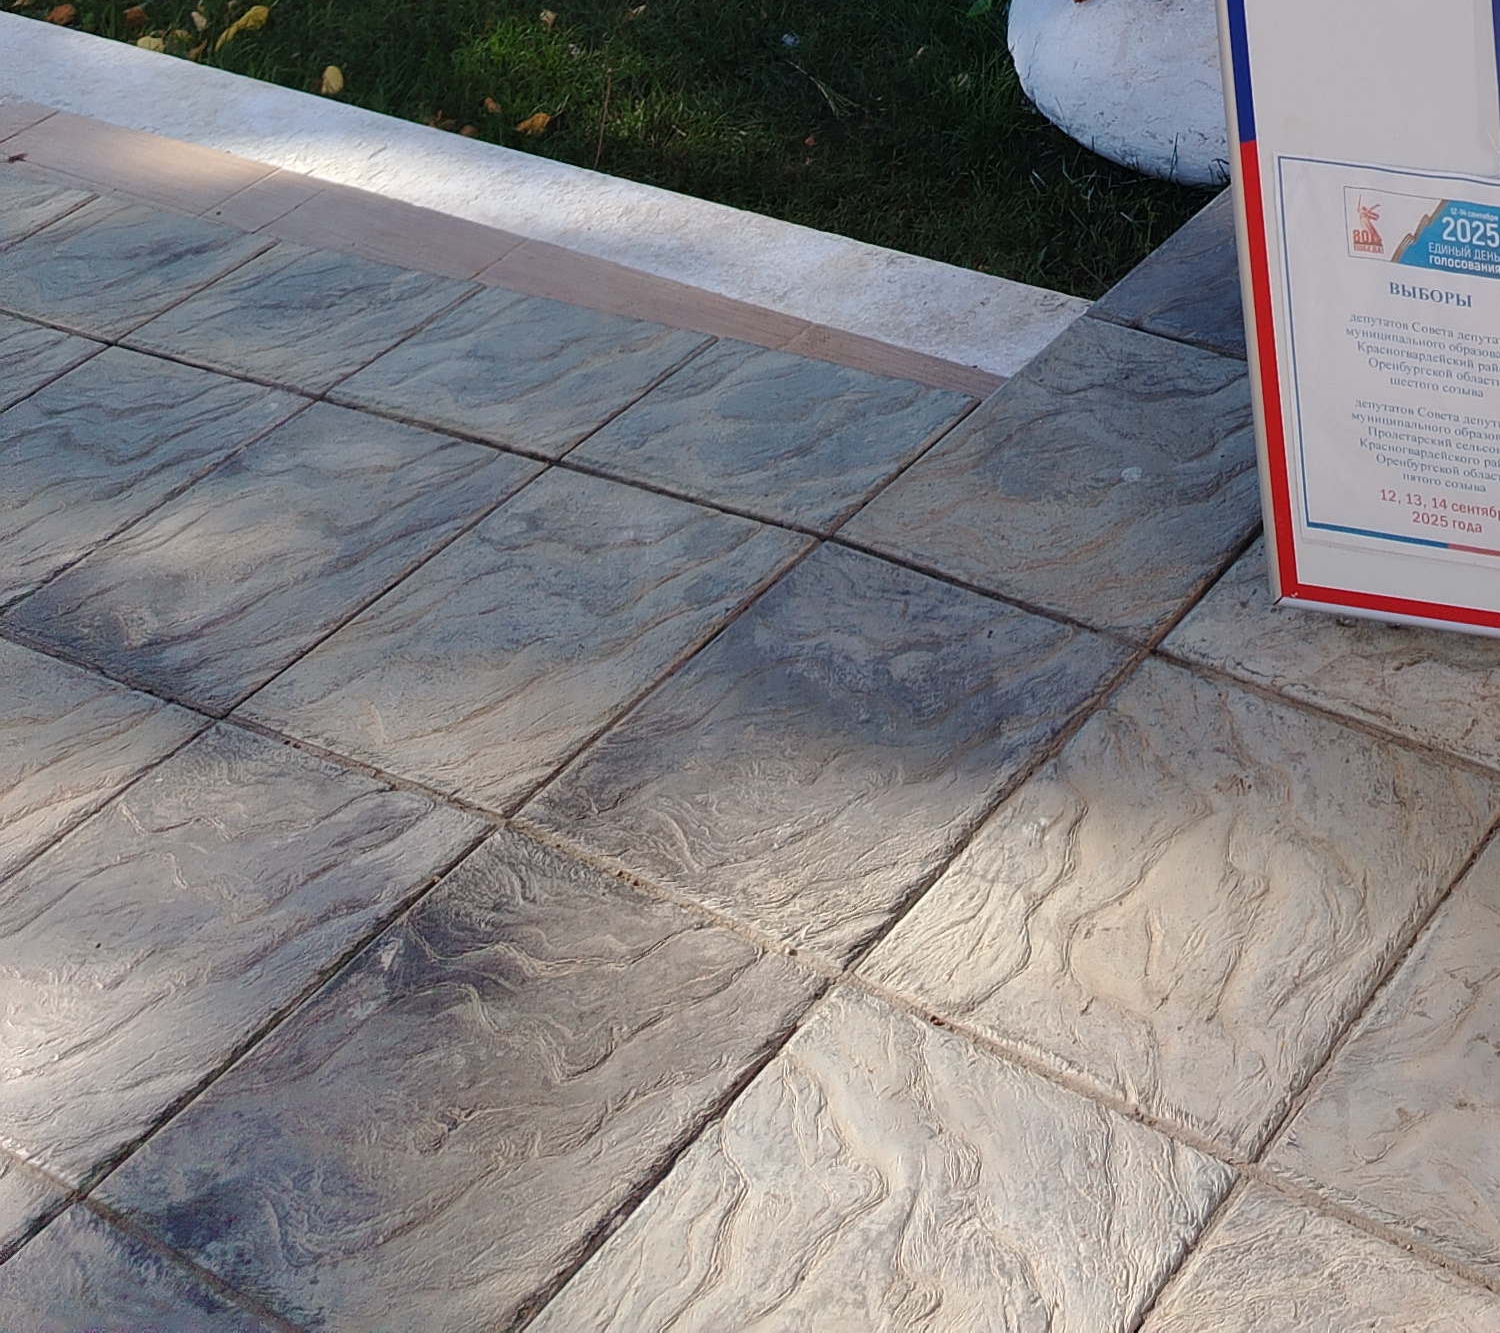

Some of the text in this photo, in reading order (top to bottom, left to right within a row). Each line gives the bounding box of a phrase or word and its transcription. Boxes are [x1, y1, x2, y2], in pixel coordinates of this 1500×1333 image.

[1353, 230, 1370, 243] 80
[1442, 217, 1499, 247] 2025
[1429, 242, 1500, 262] ЕДИНЫЙ ДЕНЬ
[1429, 256, 1500, 274] голосования
[1389, 281, 1472, 307] ВЫБОРЫ
[1349, 314, 1408, 330] депутатов
[1412, 322, 1454, 337] Совета
[1346, 328, 1445, 350] муниципального
[1357, 341, 1474, 369] Красногвардейский
[1368, 357, 1452, 379] Оренбургской
[1390, 376, 1483, 398] шестого созыва
[1355, 400, 1414, 415] депутатов
[1417, 407, 1460, 422] Совета
[1352, 413, 1450, 434] муниципального
[1368, 426, 1452, 448] Пролетарский
[1360, 438, 1480, 465] Красногвардейского
[1376, 454, 1459, 475] Оренбургской
[1403, 473, 1486, 492] пятого созыва
[1380, 489, 1401, 504] 12,
[1406, 493, 1427, 509] 13,
[1432, 497, 1447, 510] 14
[1412, 511, 1482, 533] 2025 года
